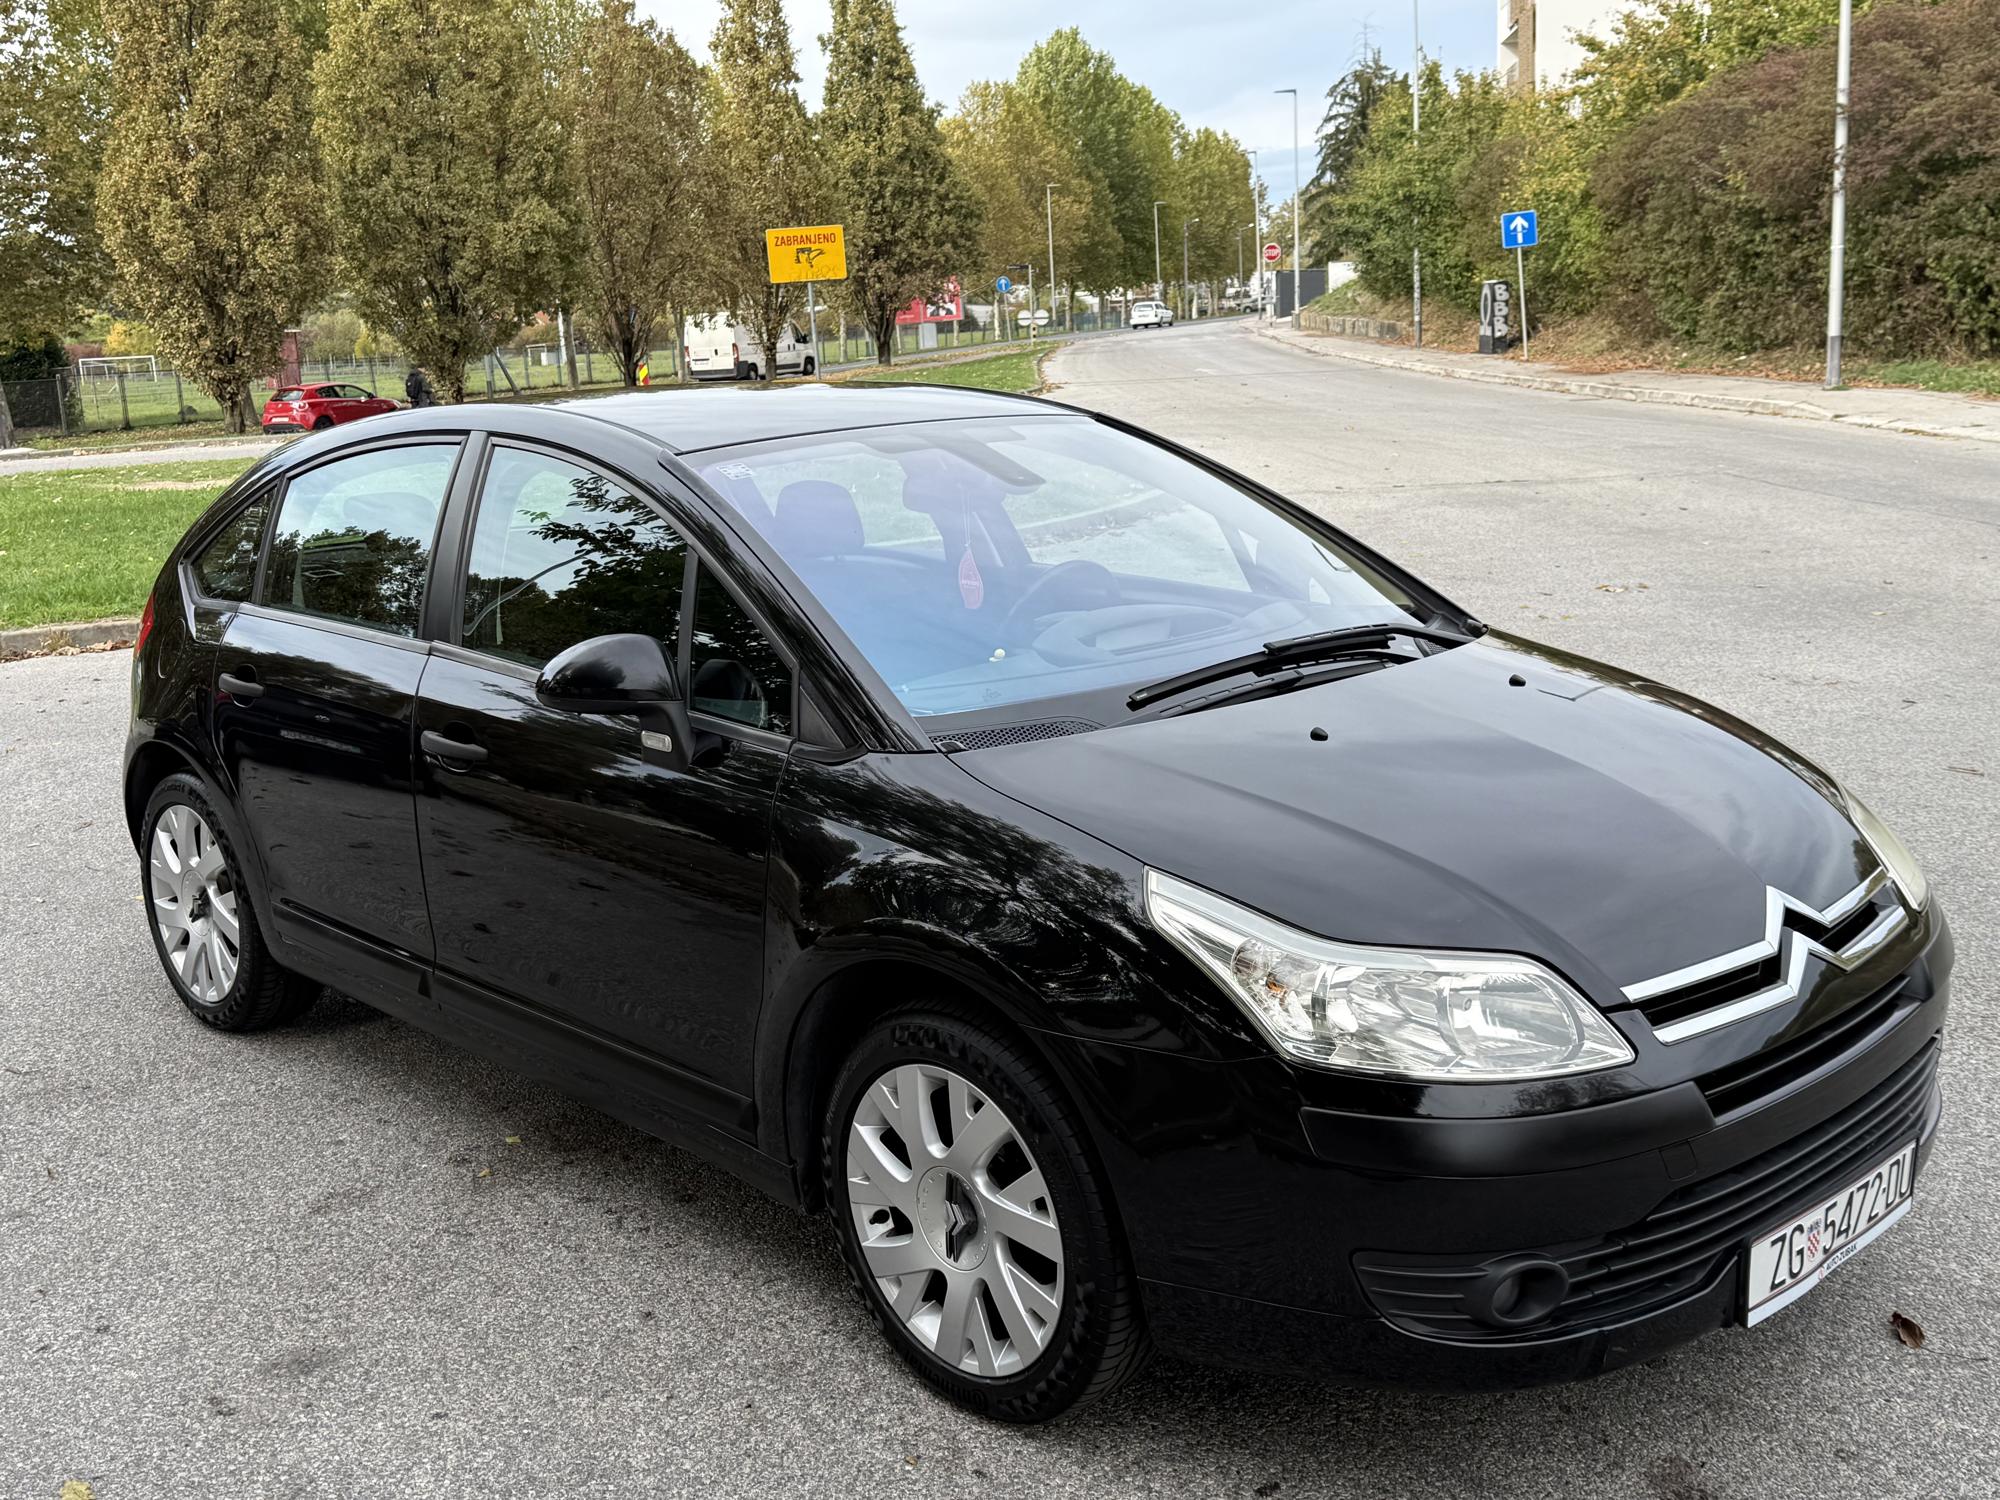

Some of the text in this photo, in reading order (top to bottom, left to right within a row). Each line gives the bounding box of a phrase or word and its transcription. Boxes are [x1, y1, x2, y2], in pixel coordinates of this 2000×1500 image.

[774, 232, 837, 247] ZABRANJENO
[1770, 1146, 1915, 1293] ZG 5472-DU
